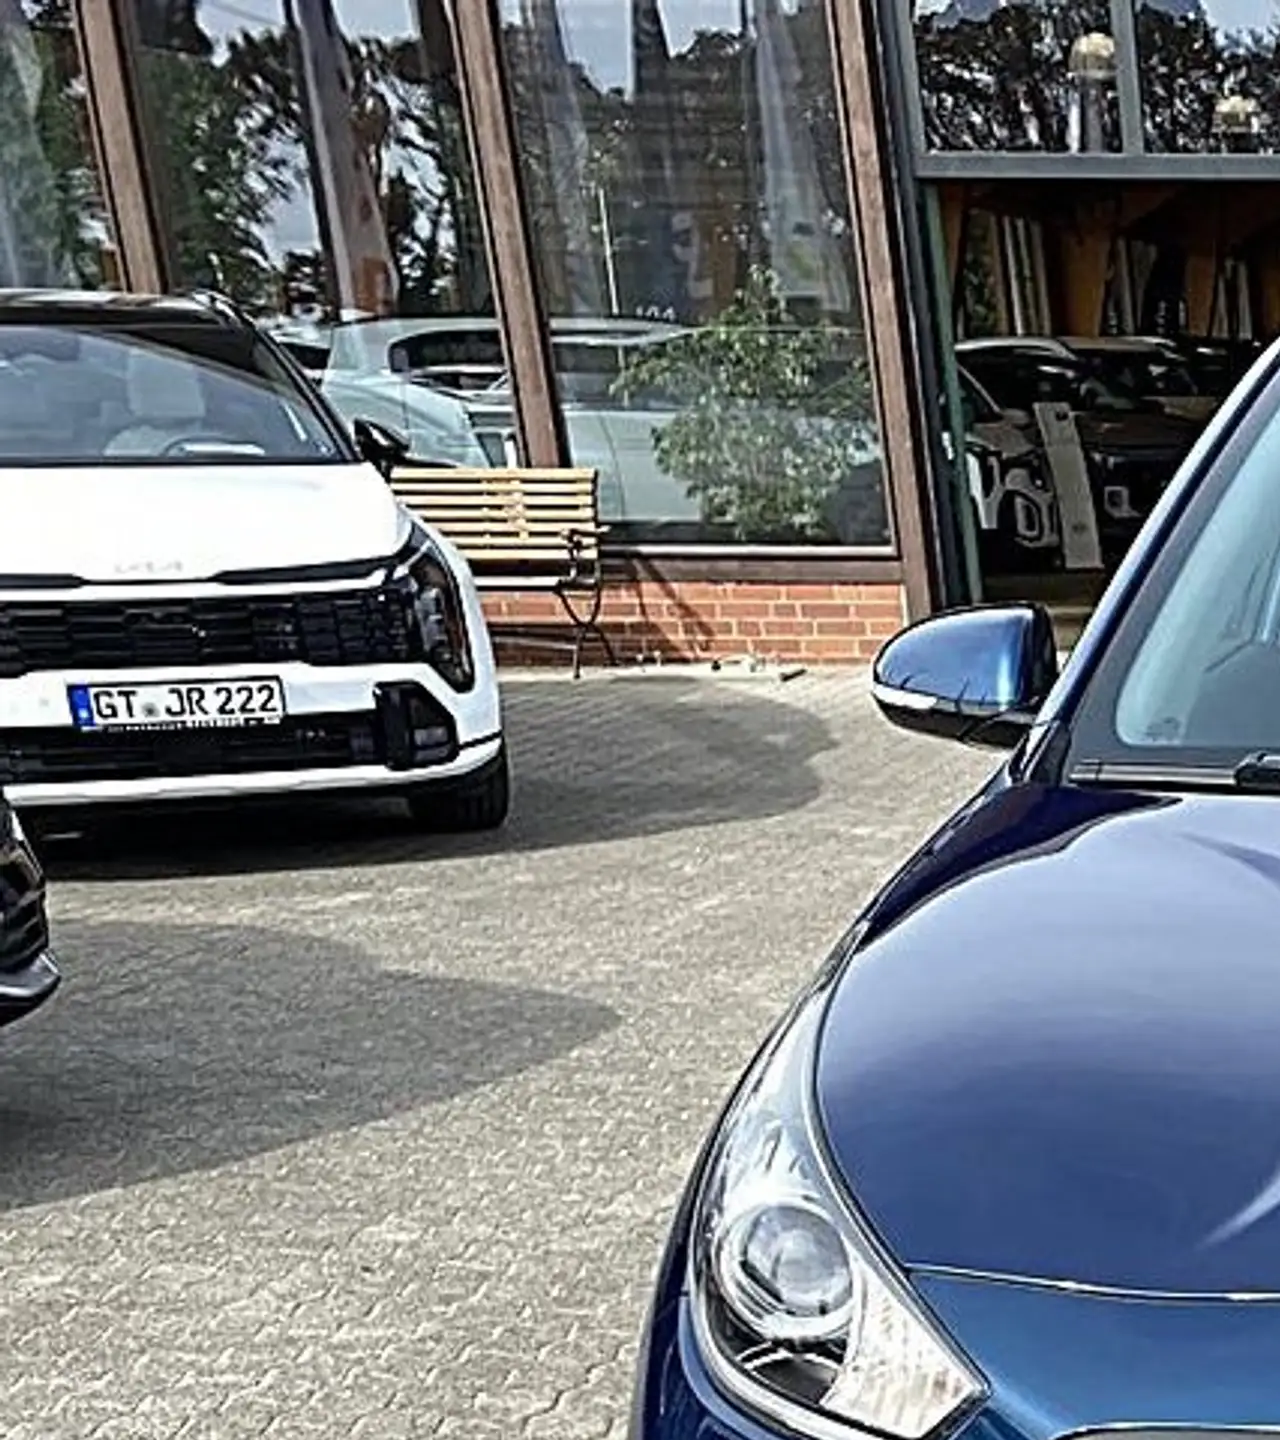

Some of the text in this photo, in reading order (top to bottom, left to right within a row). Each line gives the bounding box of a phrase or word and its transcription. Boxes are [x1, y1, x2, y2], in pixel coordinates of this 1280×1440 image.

[93, 684, 278, 719] GT JR 222
